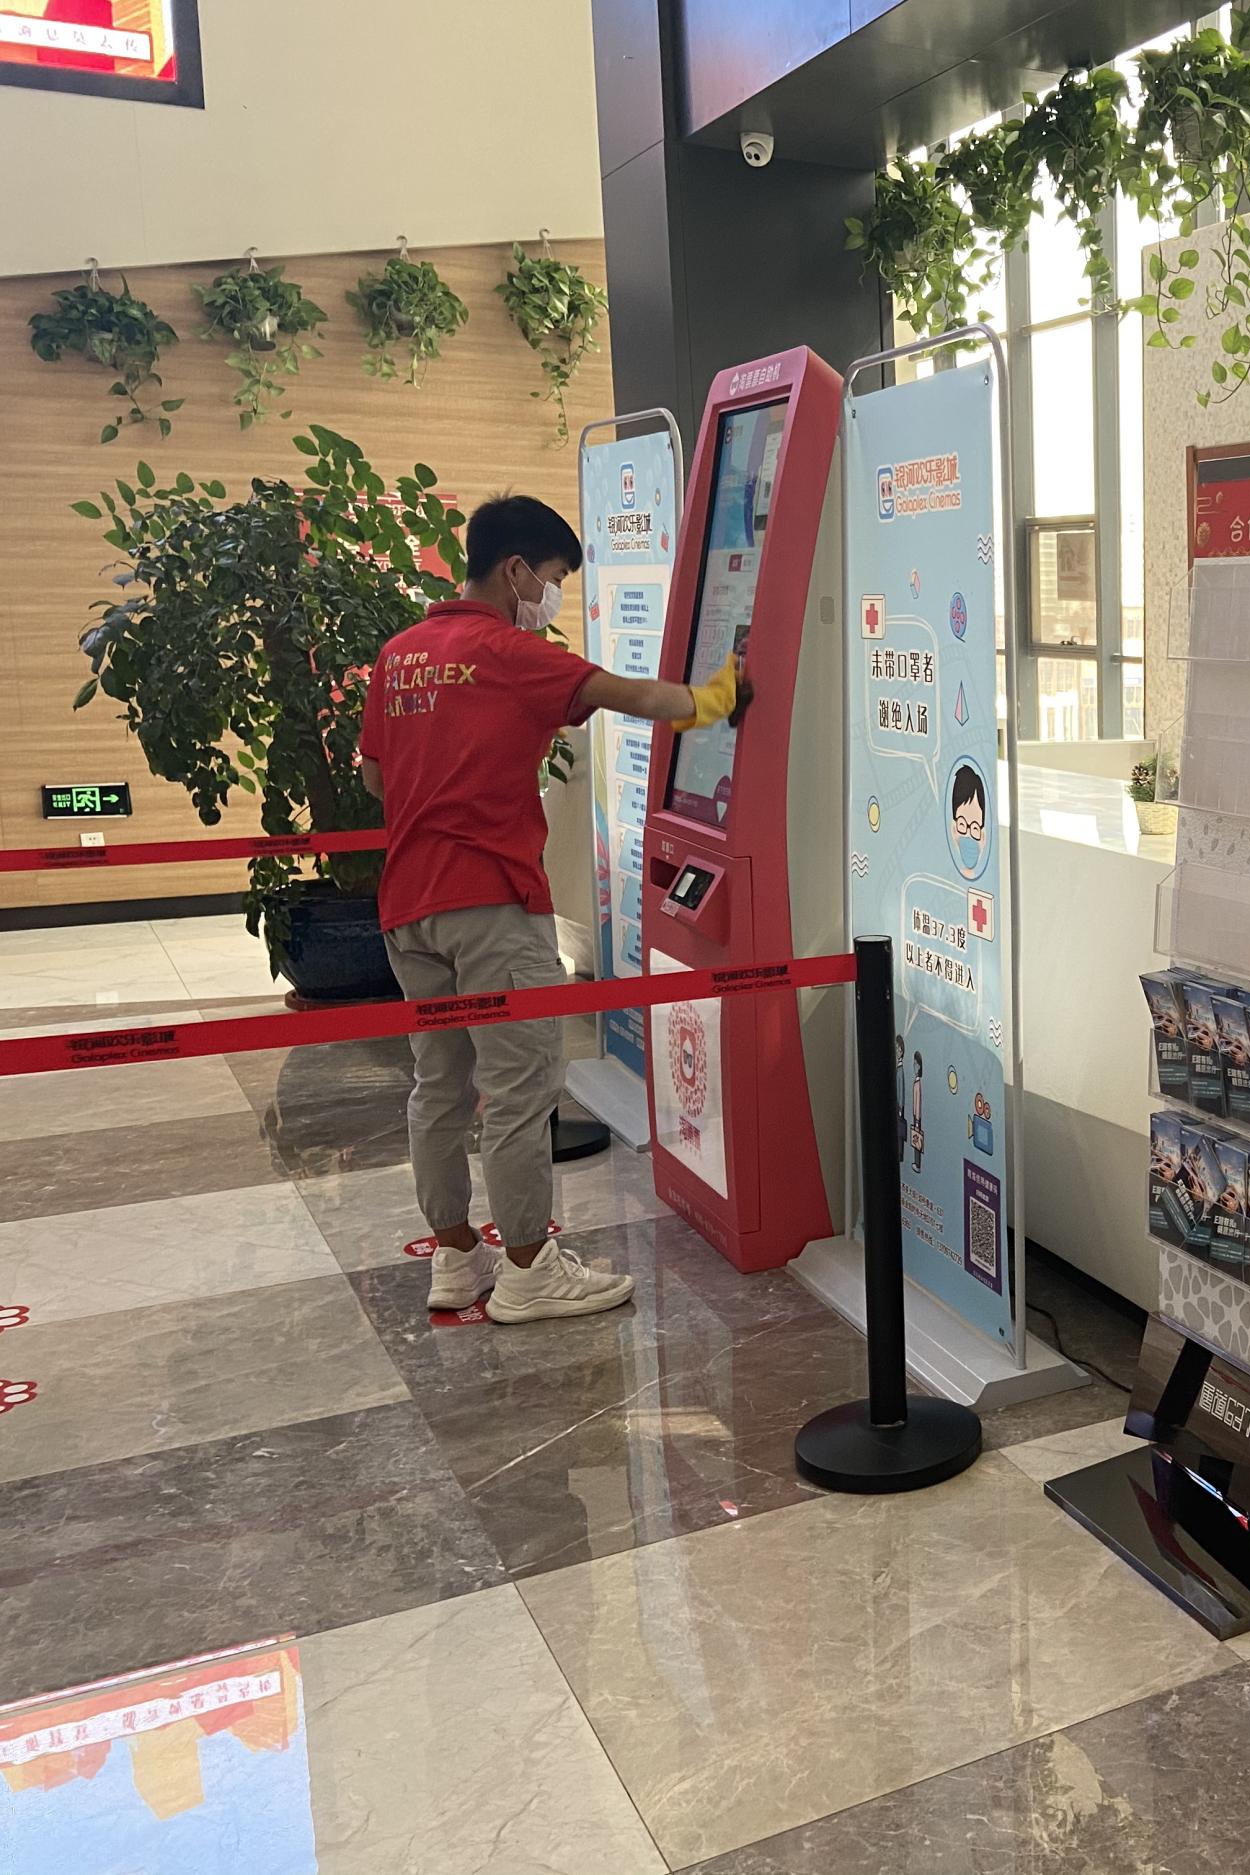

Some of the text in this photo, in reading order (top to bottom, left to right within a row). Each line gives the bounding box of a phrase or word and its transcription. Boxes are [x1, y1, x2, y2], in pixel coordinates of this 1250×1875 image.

[894, 455, 960, 491] 银河欢乐影城
[403, 651, 428, 666] are
[872, 649, 934, 683] 未带口罩者
[879, 699, 928, 735] 谢绝入场
[913, 909, 966, 951] 体温37.3度
[906, 943, 975, 991] 以上者不得进入
